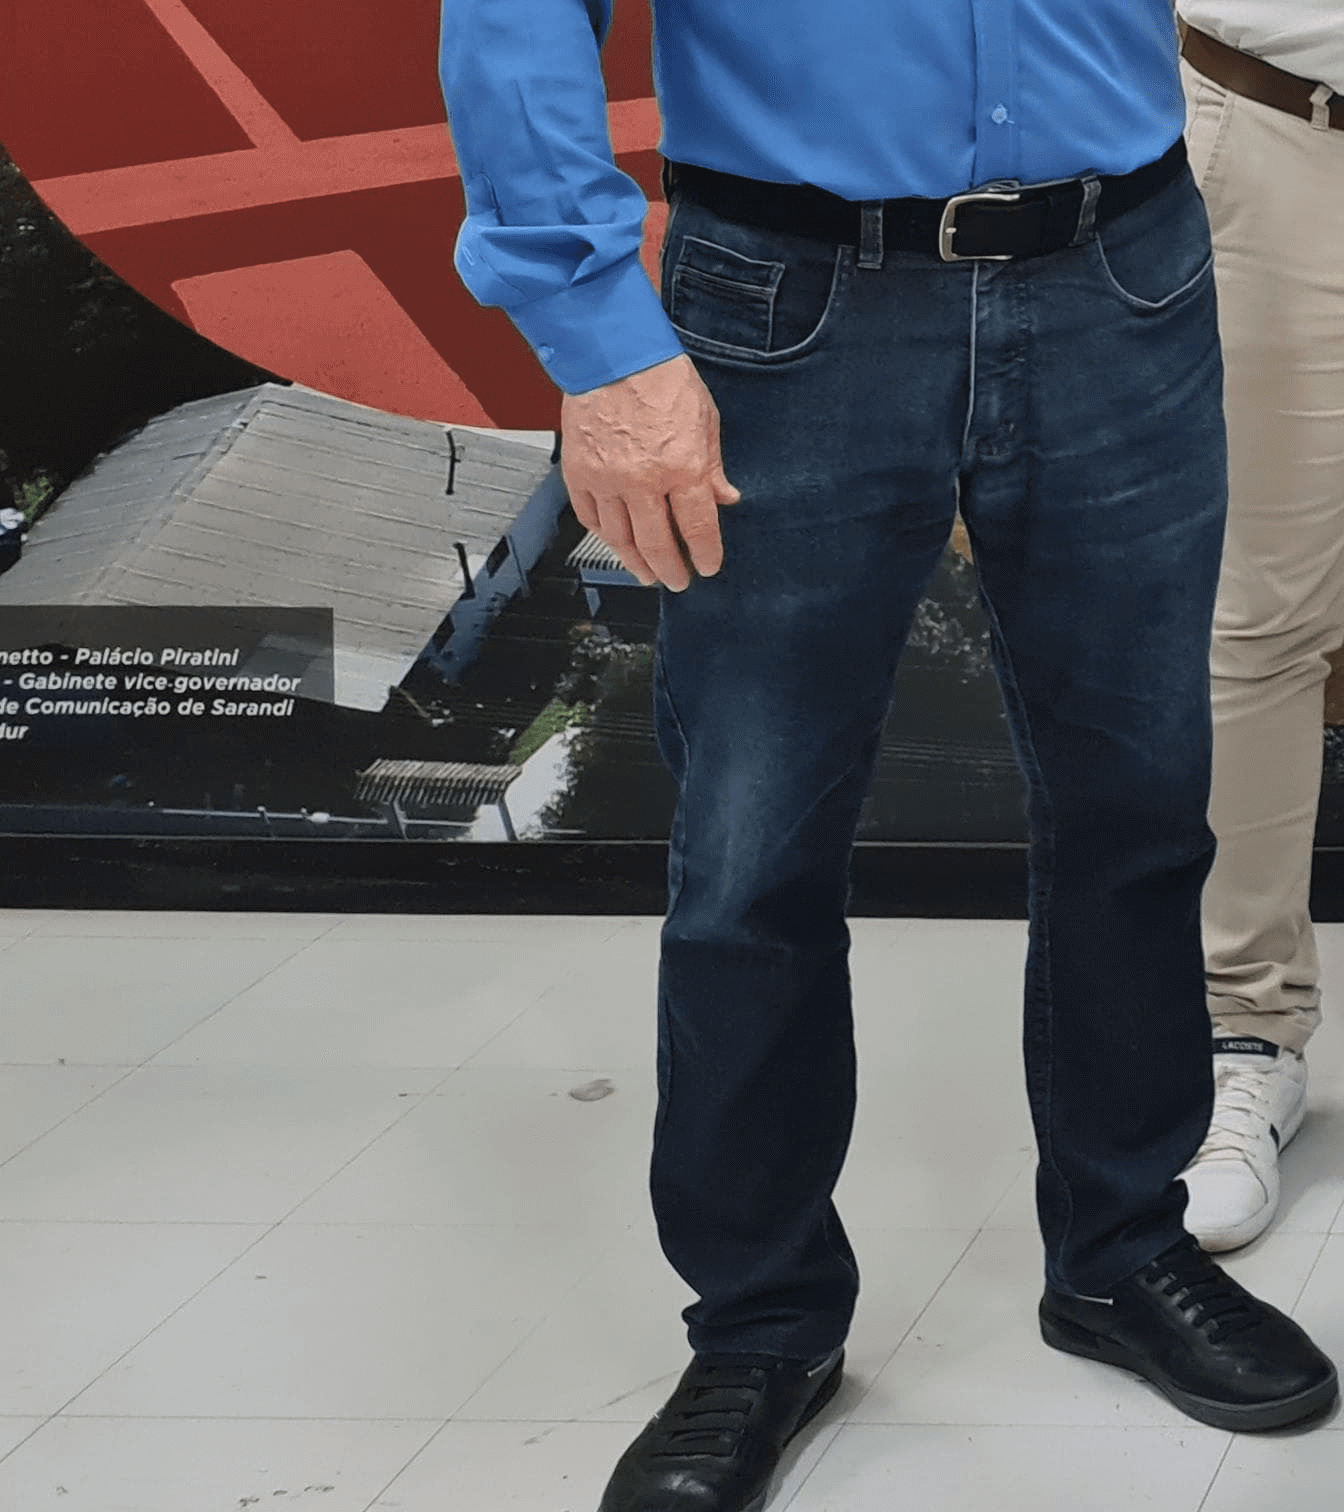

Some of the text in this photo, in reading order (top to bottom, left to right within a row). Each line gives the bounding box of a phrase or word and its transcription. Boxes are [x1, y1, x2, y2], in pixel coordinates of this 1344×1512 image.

[75, 646, 154, 666] Palácio
[160, 647, 240, 666] Piratini
[19, 672, 118, 690] Gabinete
[124, 672, 302, 694] vice-governador
[26, 697, 171, 718] Comunicação
[178, 697, 205, 716] de
[211, 697, 295, 716] Sarandi
